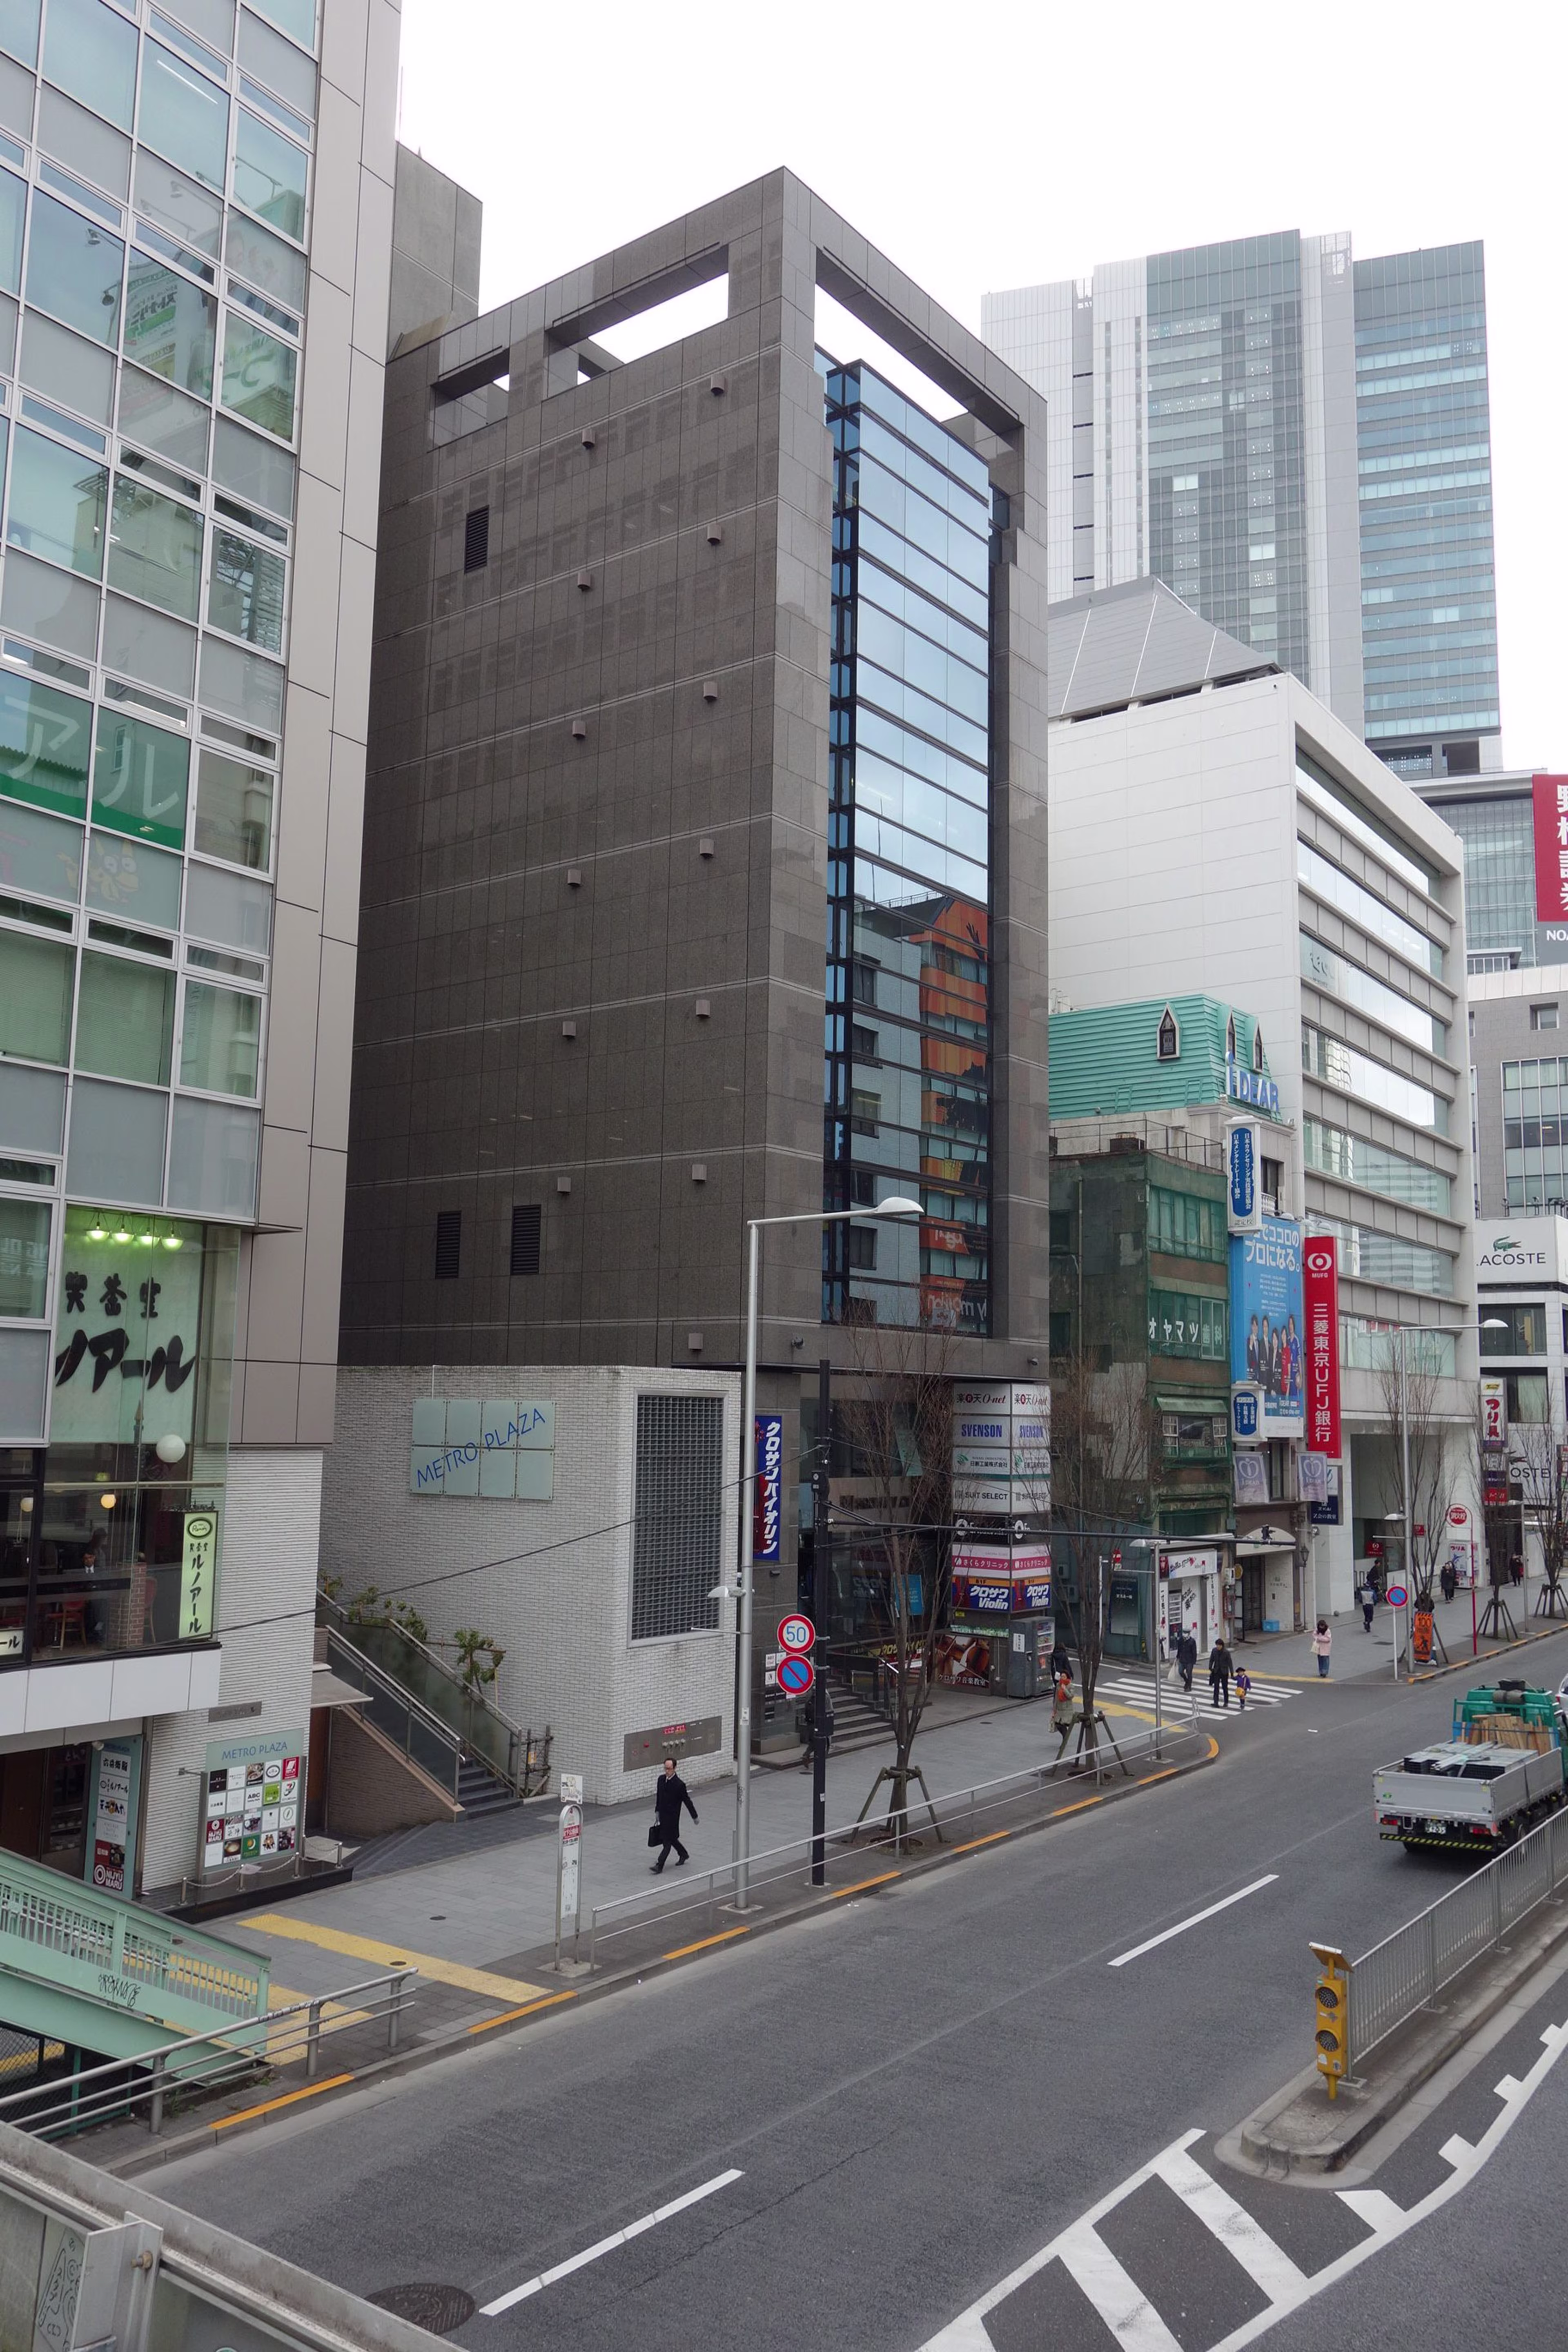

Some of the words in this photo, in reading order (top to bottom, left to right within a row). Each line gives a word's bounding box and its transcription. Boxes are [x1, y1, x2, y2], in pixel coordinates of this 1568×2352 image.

[1546, 930, 1568, 941] NO
[1253, 1225, 1299, 1247] でココロの
[1245, 1240, 1300, 1272] プロになる。
[1476, 1253, 1546, 1266] ACOSTE
[55, 1327, 196, 1393] ノアール
[1313, 1303, 1331, 1442] 三菱東京UFJ銀行
[1485, 1399, 1501, 1437] つり具
[961, 1424, 1002, 1438] SVENSON
[1019, 1425, 1044, 1438] SVENSON
[416, 1442, 478, 1488] METRO
[485, 1408, 546, 1452] PLAZA
[763, 1421, 781, 1554] クロサワバイオリン
[963, 1559, 1009, 1569] さくらクリニック
[1020, 1559, 1048, 1568] さくらクリニック
[189, 1554, 205, 1633] ルノアール
[970, 1586, 1009, 1597] クロサワ
[1027, 1584, 1049, 1597] クロサワ
[979, 1597, 1009, 1610] Violin
[1031, 1596, 1049, 1607] Violin
[786, 1626, 806, 1643] 50
[937, 1675, 987, 1685] クロサワ音楽教室
[222, 1746, 256, 1761] METRO
[259, 1741, 287, 1754] PLAZA
[105, 1879, 122, 1890] MARU
